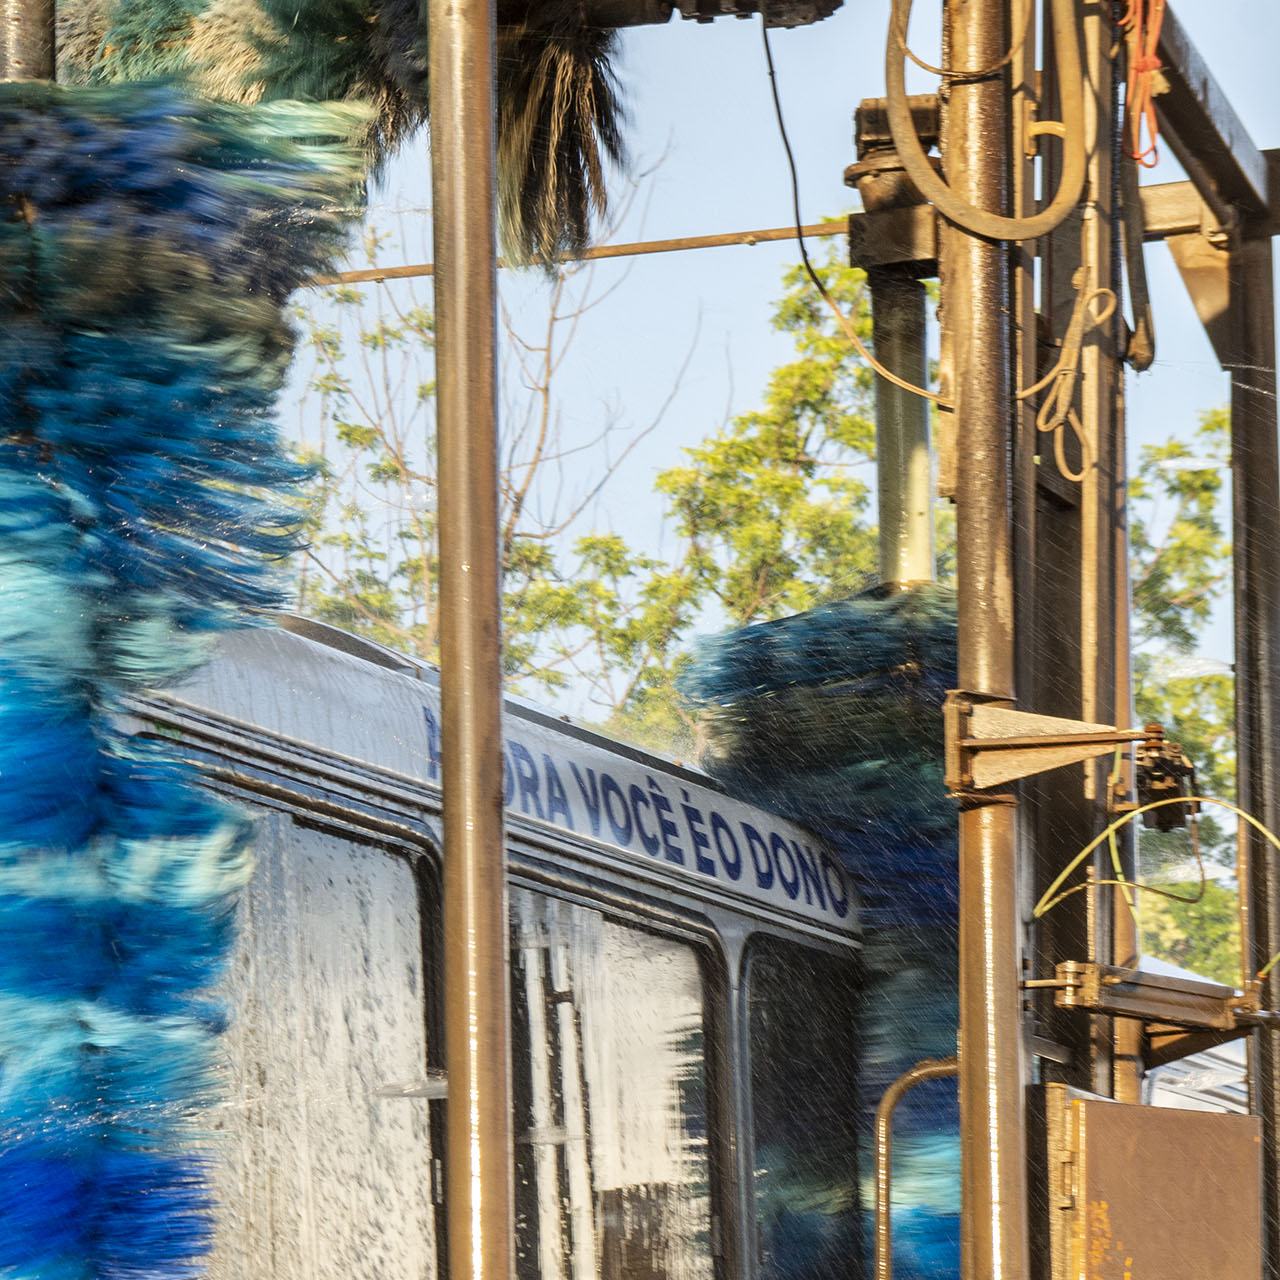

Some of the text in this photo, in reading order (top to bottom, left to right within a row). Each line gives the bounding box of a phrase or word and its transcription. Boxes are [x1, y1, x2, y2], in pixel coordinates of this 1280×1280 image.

[568, 760, 685, 866] VOCÊ
[680, 787, 717, 877] É
[710, 811, 742, 881] O
[739, 820, 849, 919] DONO
